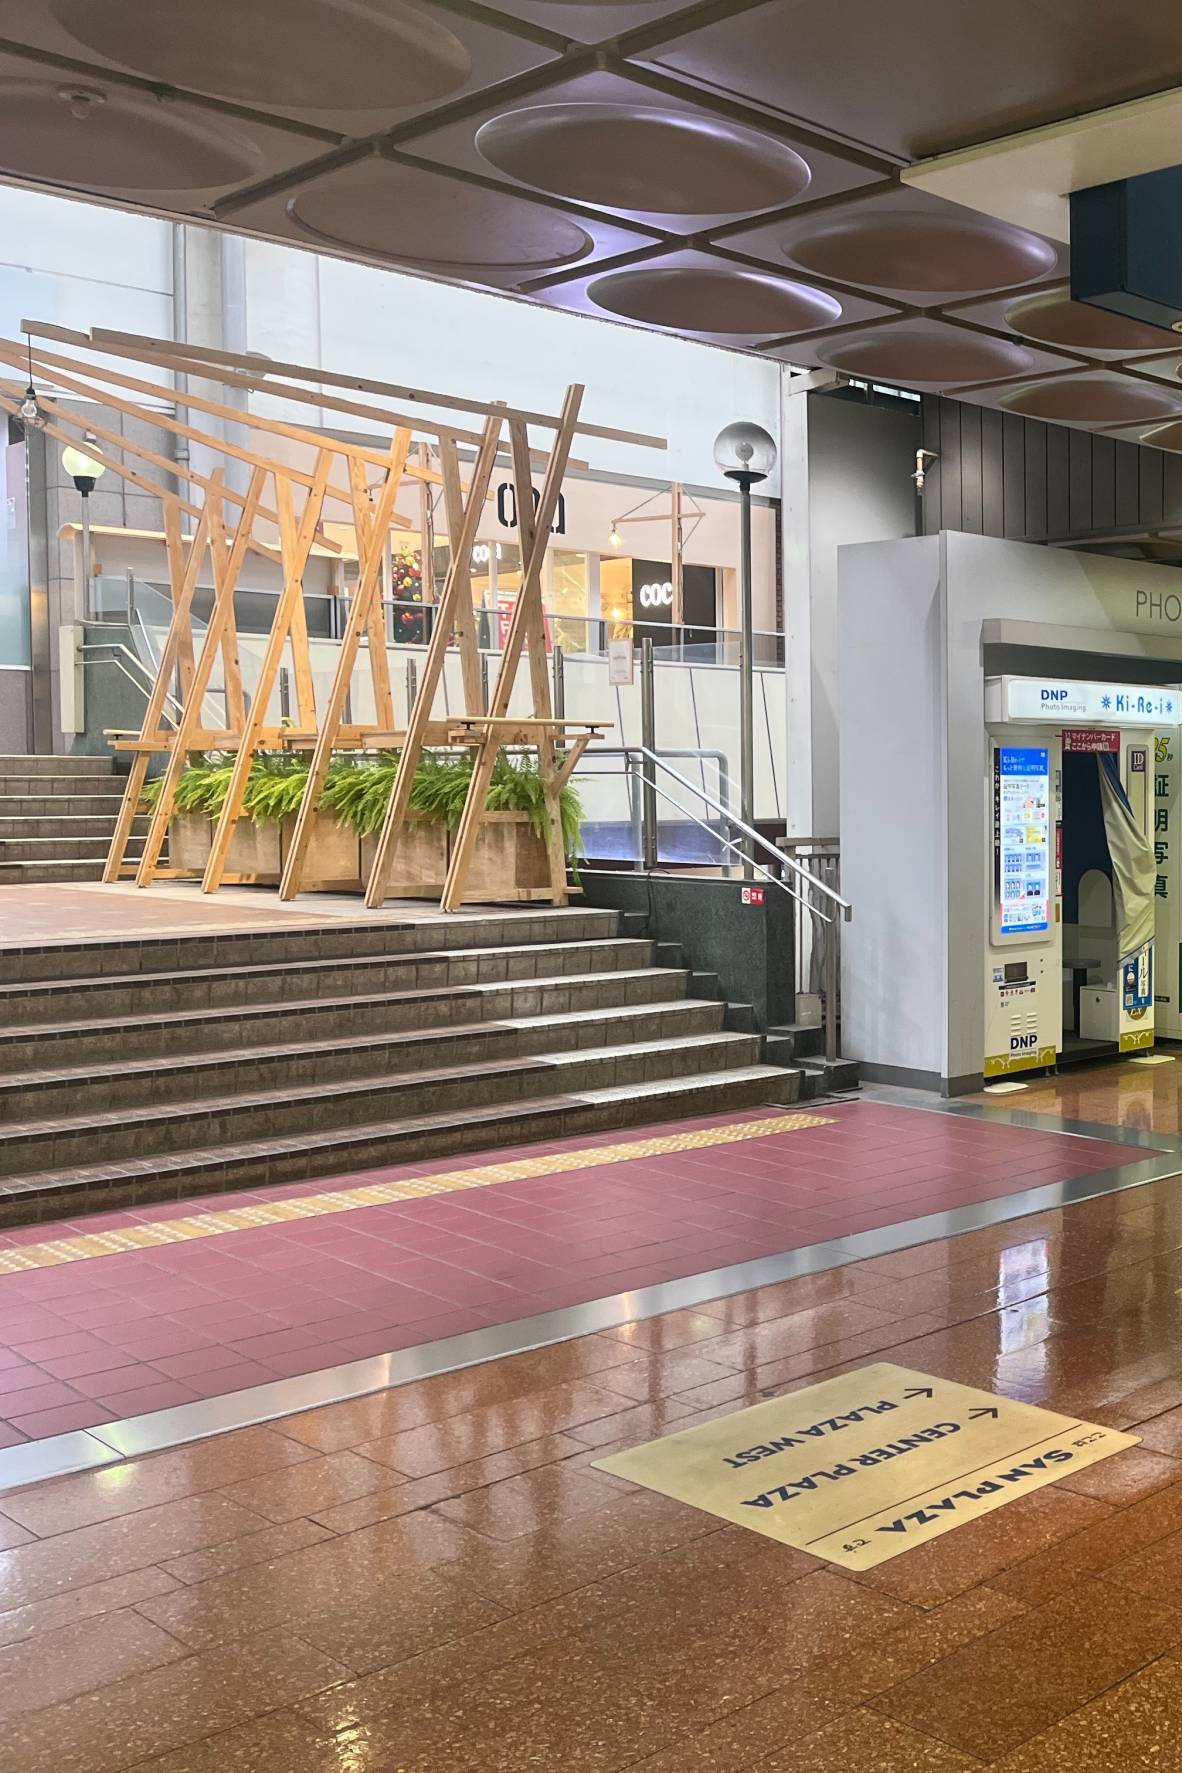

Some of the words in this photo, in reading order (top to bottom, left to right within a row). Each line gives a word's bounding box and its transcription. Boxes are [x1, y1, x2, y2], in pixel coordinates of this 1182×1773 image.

[1040, 689, 1069, 701] DNP
[1115, 693, 1164, 715] Ki-Re-i
[1041, 702, 1060, 711] Photo
[1071, 731, 1116, 742] マイナンバーカード
[1133, 752, 1145, 765] ID
[1010, 1035, 1037, 1050] DNP
[795, 1400, 900, 1438] PLAZA
[848, 1422, 962, 1467] CENTER
[1071, 1432, 1107, 1448] ここは
[722, 1437, 807, 1469] WEST
[997, 1449, 1074, 1483] SAN
[740, 1463, 858, 1508] PLAZA
[874, 1481, 1005, 1533] PLAZA
[842, 1538, 872, 1554] です
